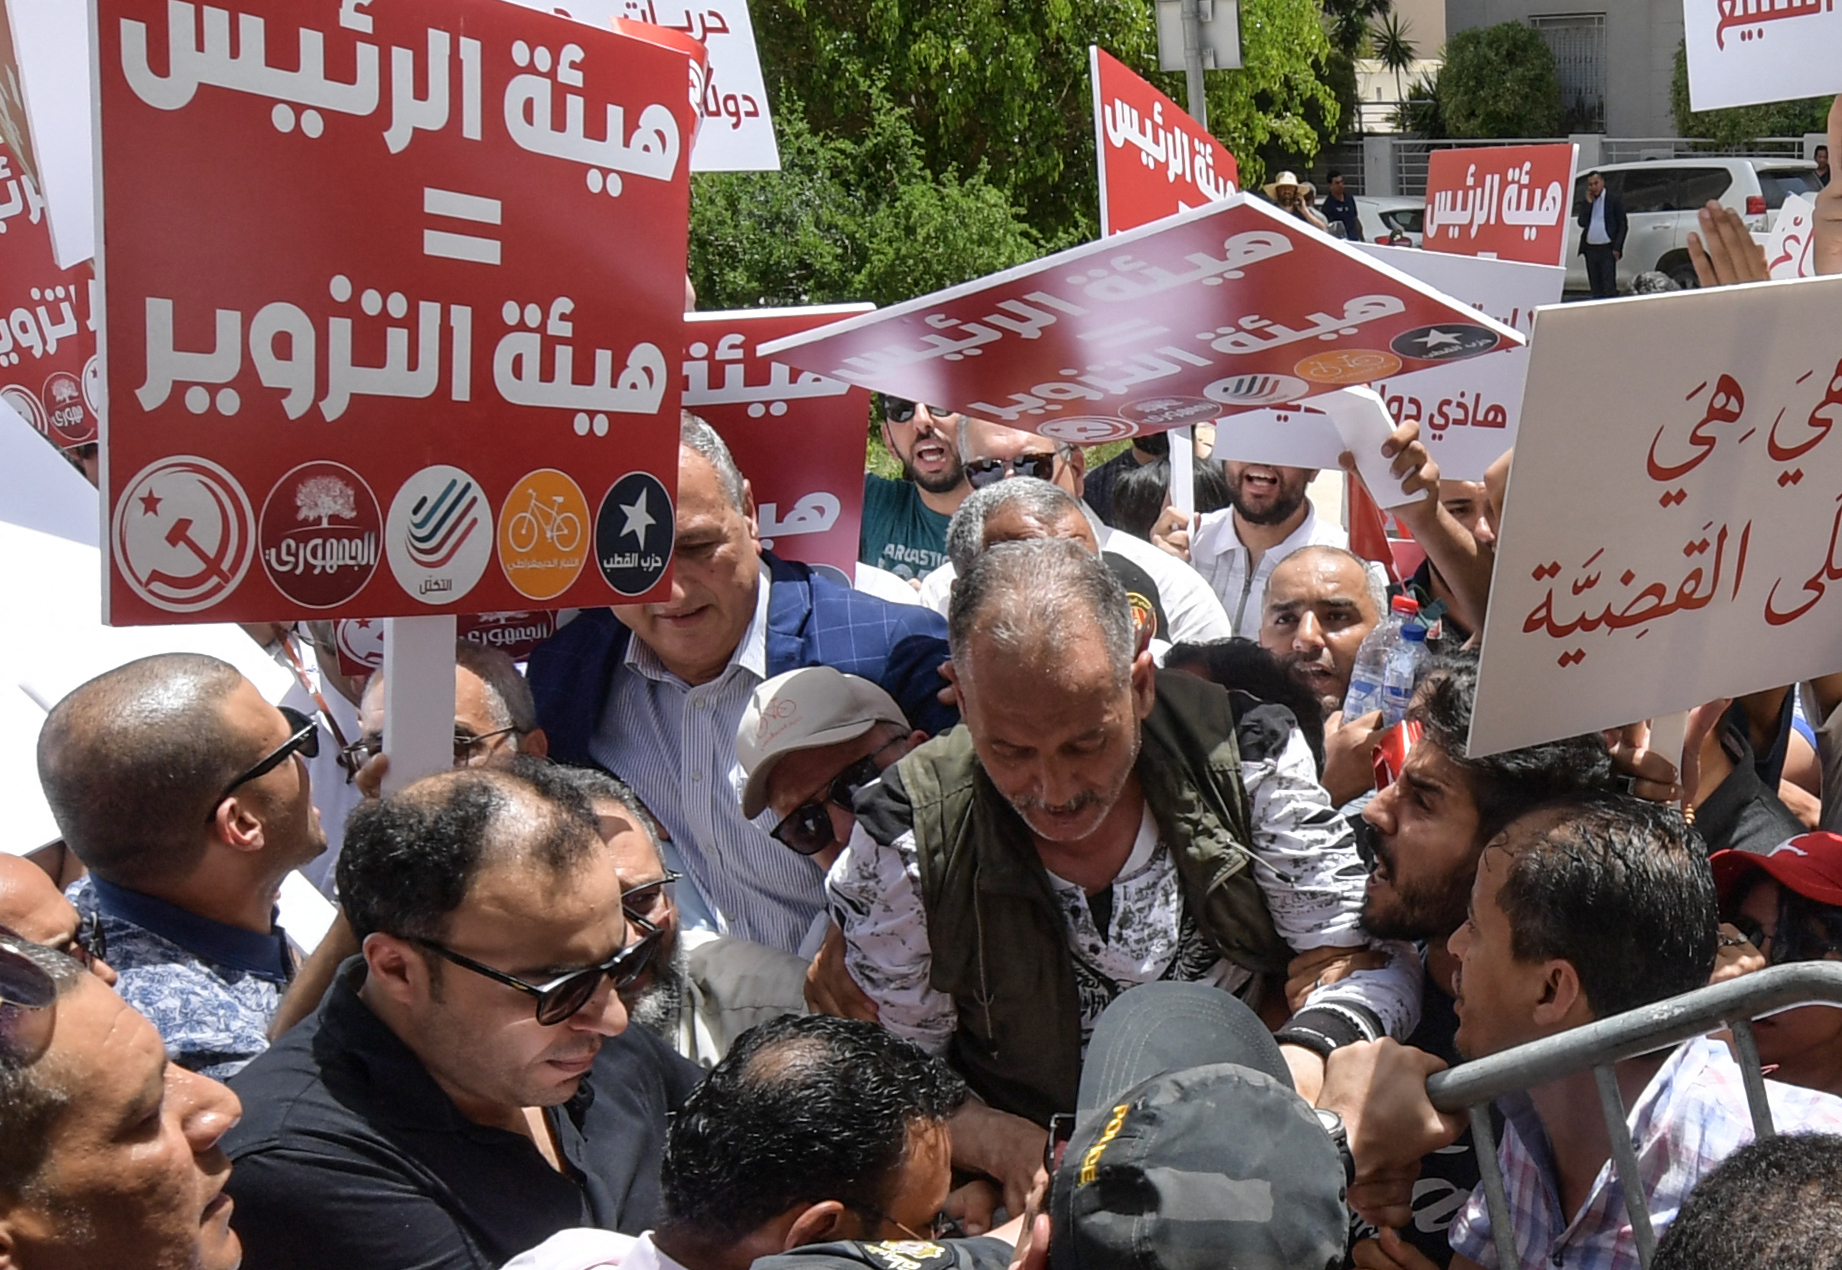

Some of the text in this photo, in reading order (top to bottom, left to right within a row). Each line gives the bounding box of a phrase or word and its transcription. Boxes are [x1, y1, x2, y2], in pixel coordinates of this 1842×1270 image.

[118, 0, 681, 198] هيئة الرئيس
[1104, 97, 1192, 183] الرئيس
[1426, 160, 1563, 241] هيئة الرئيس
[1066, 230, 1295, 301] هيئة
[135, 274, 667, 437] هيئة التزوير
[1196, 294, 1407, 356] هيئة
[682, 333, 851, 418] هيئ
[1428, 390, 1508, 442] هاذي
[265, 531, 376, 575] الجمهوري
[603, 553, 663, 573] حزب القطب
